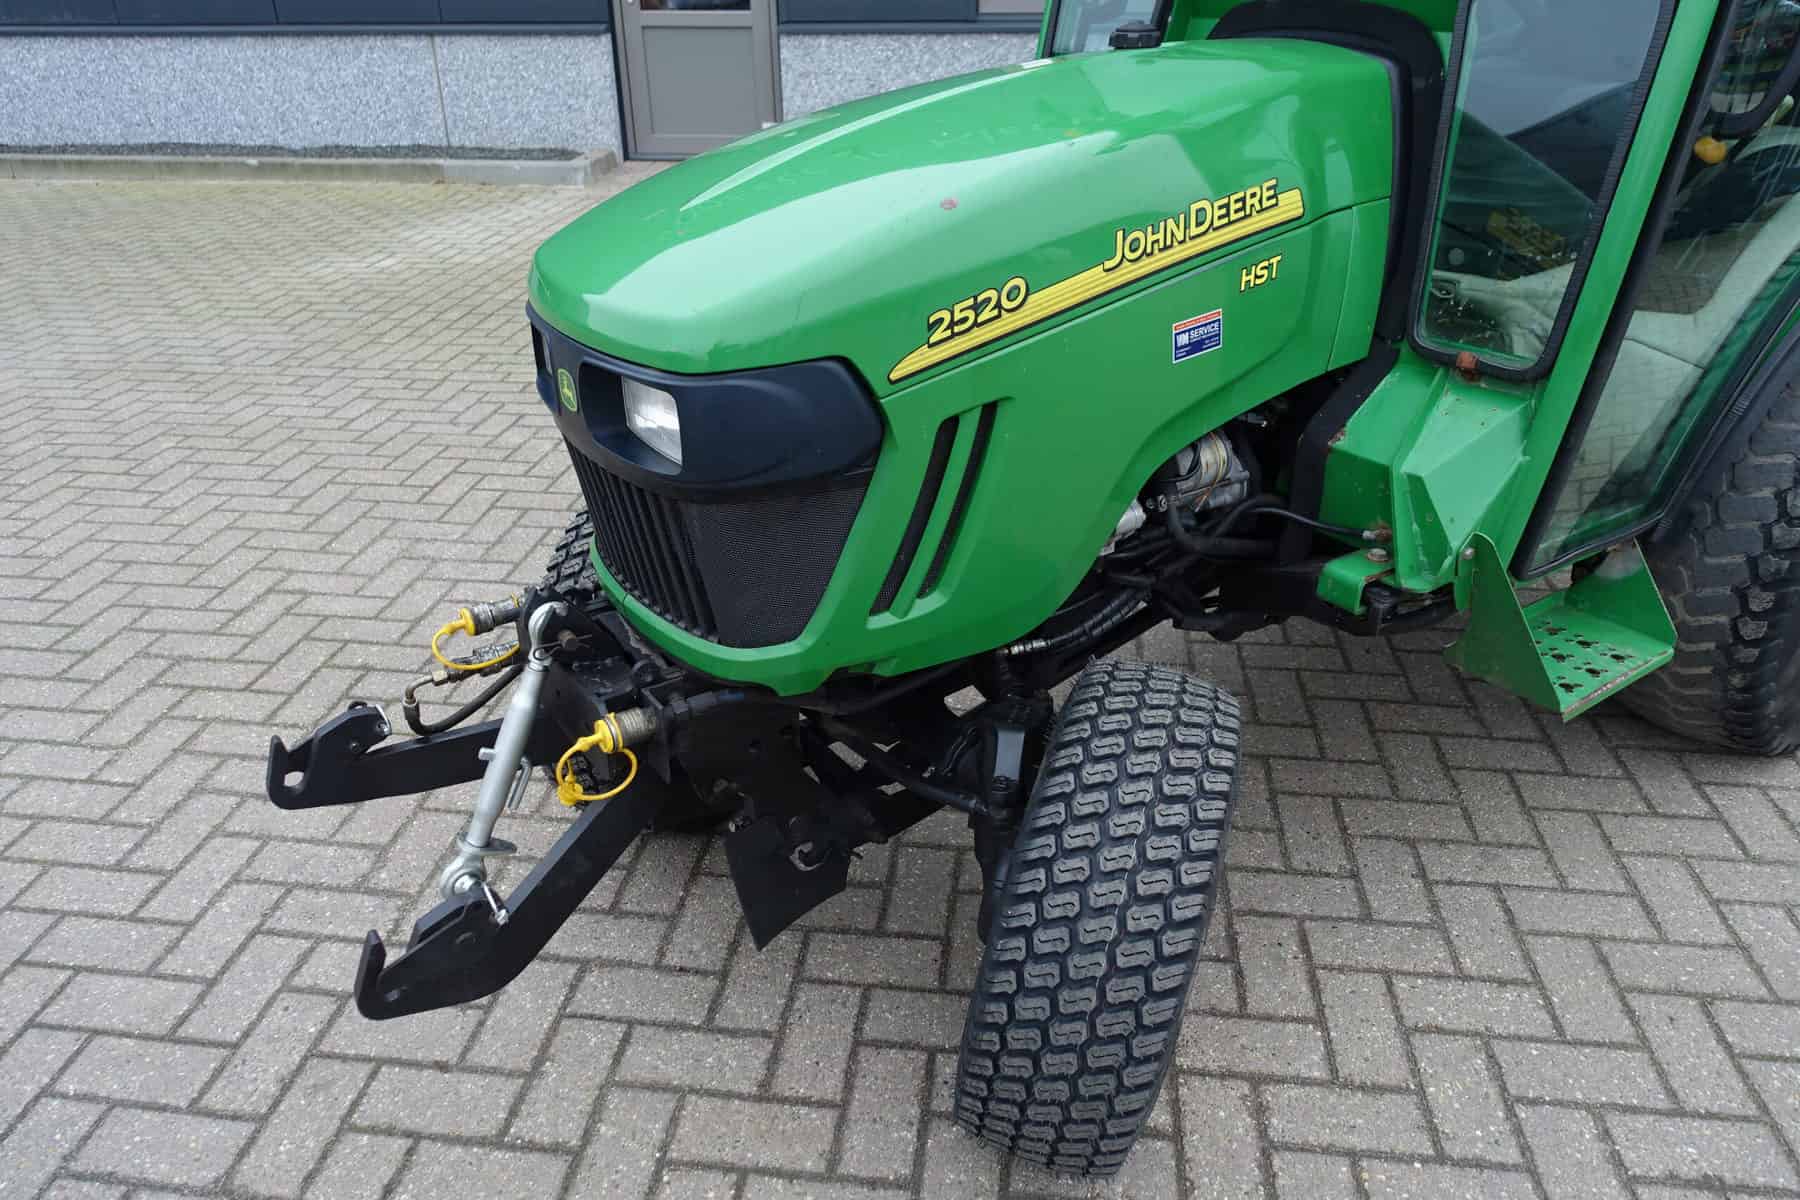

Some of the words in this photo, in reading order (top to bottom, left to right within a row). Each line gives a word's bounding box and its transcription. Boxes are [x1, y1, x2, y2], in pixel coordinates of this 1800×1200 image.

[1103, 213, 1185, 271] JOHN
[1189, 178, 1279, 239] DEERE
[1240, 254, 1282, 292] HST
[927, 276, 1028, 347] 2520
[1190, 321, 1219, 339] SERVICE
